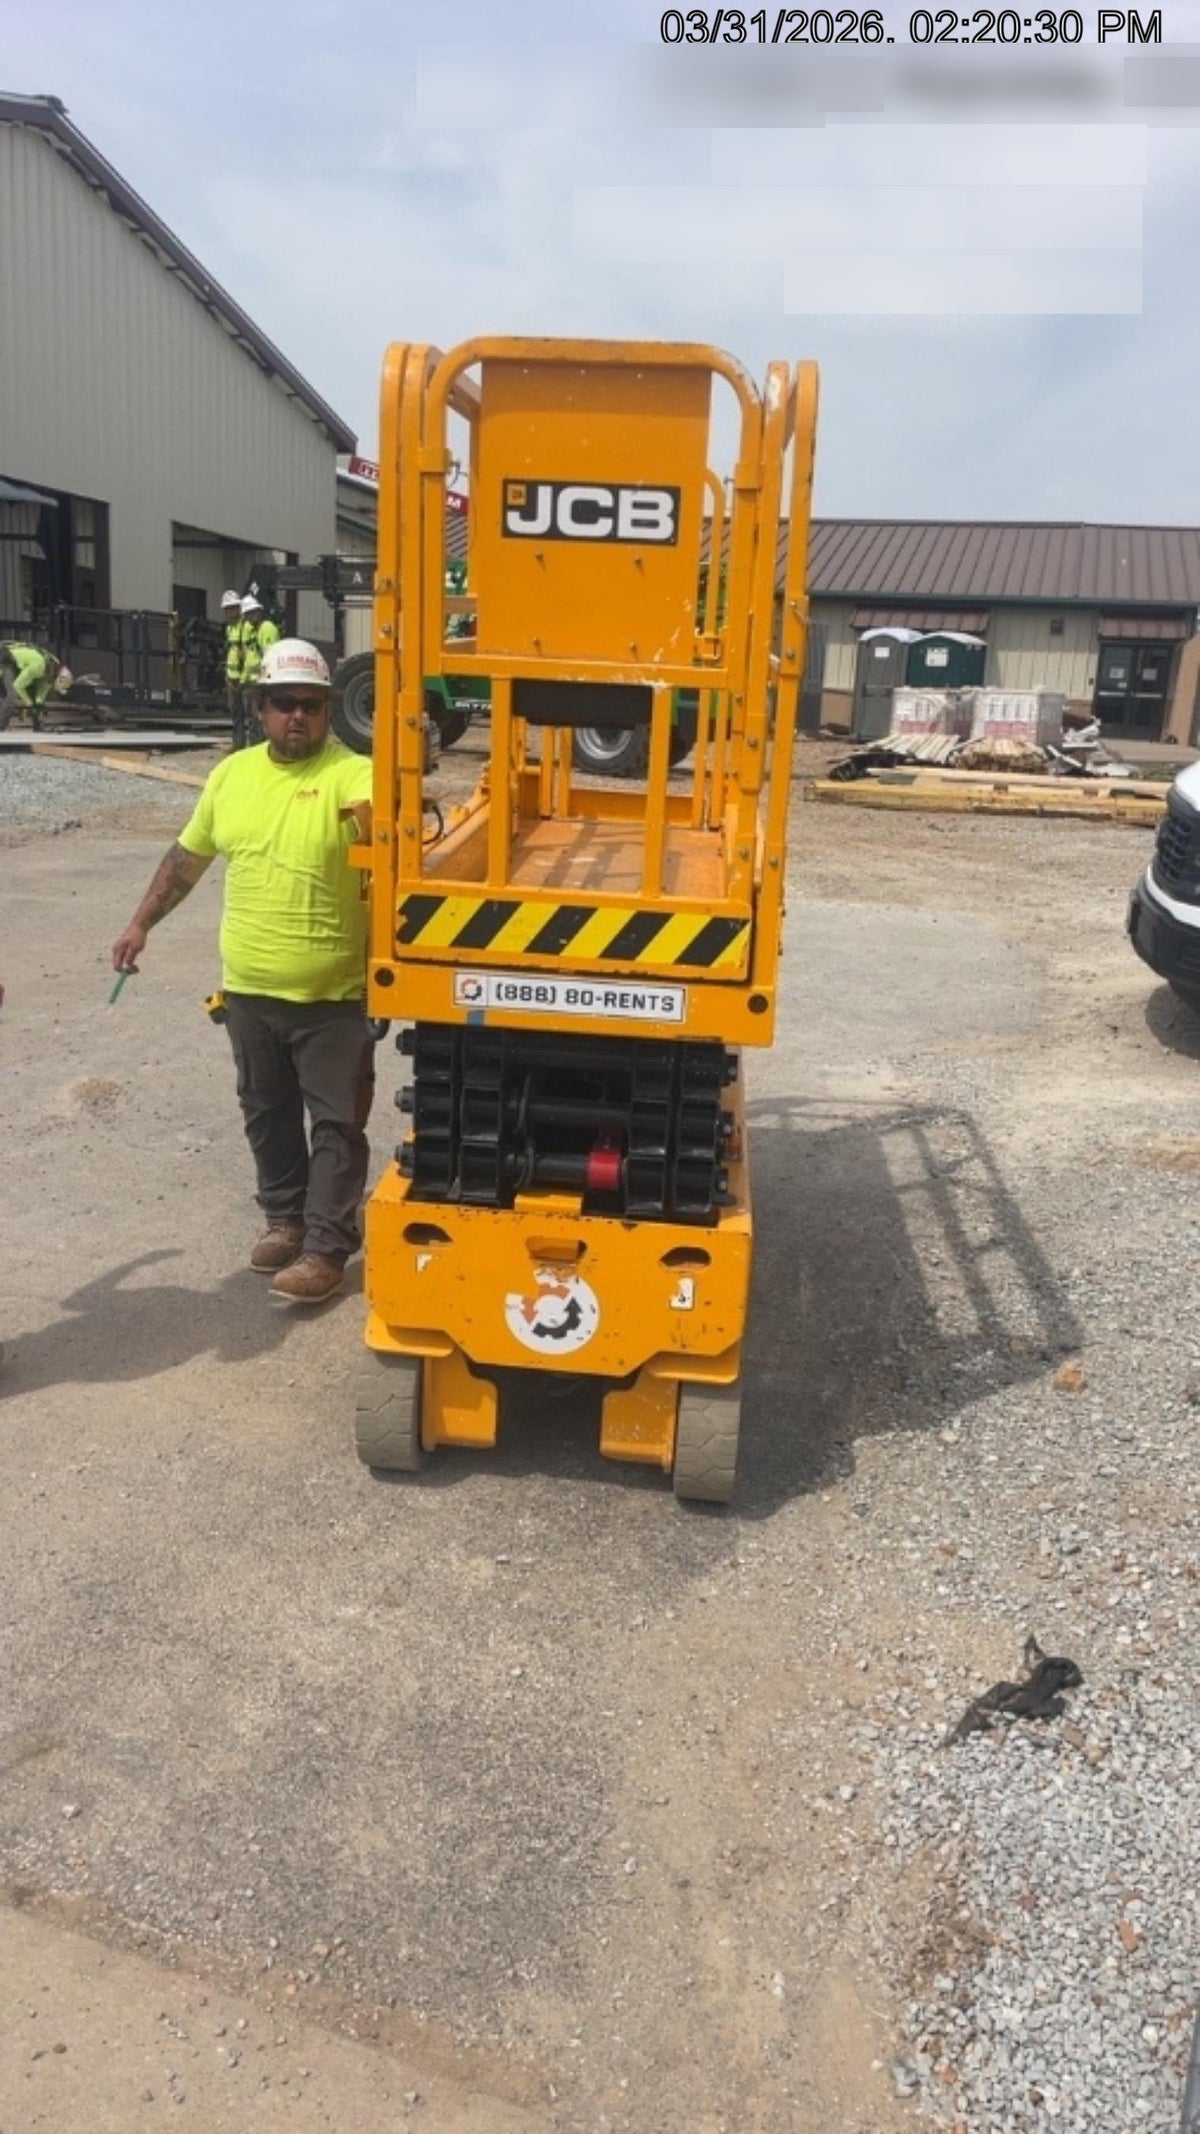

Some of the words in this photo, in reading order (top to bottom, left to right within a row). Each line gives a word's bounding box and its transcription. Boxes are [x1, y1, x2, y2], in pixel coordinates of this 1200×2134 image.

[506, 485, 675, 539] JCB
[495, 983, 557, 1005] (888)
[564, 988, 675, 1013] 80-RENTS
